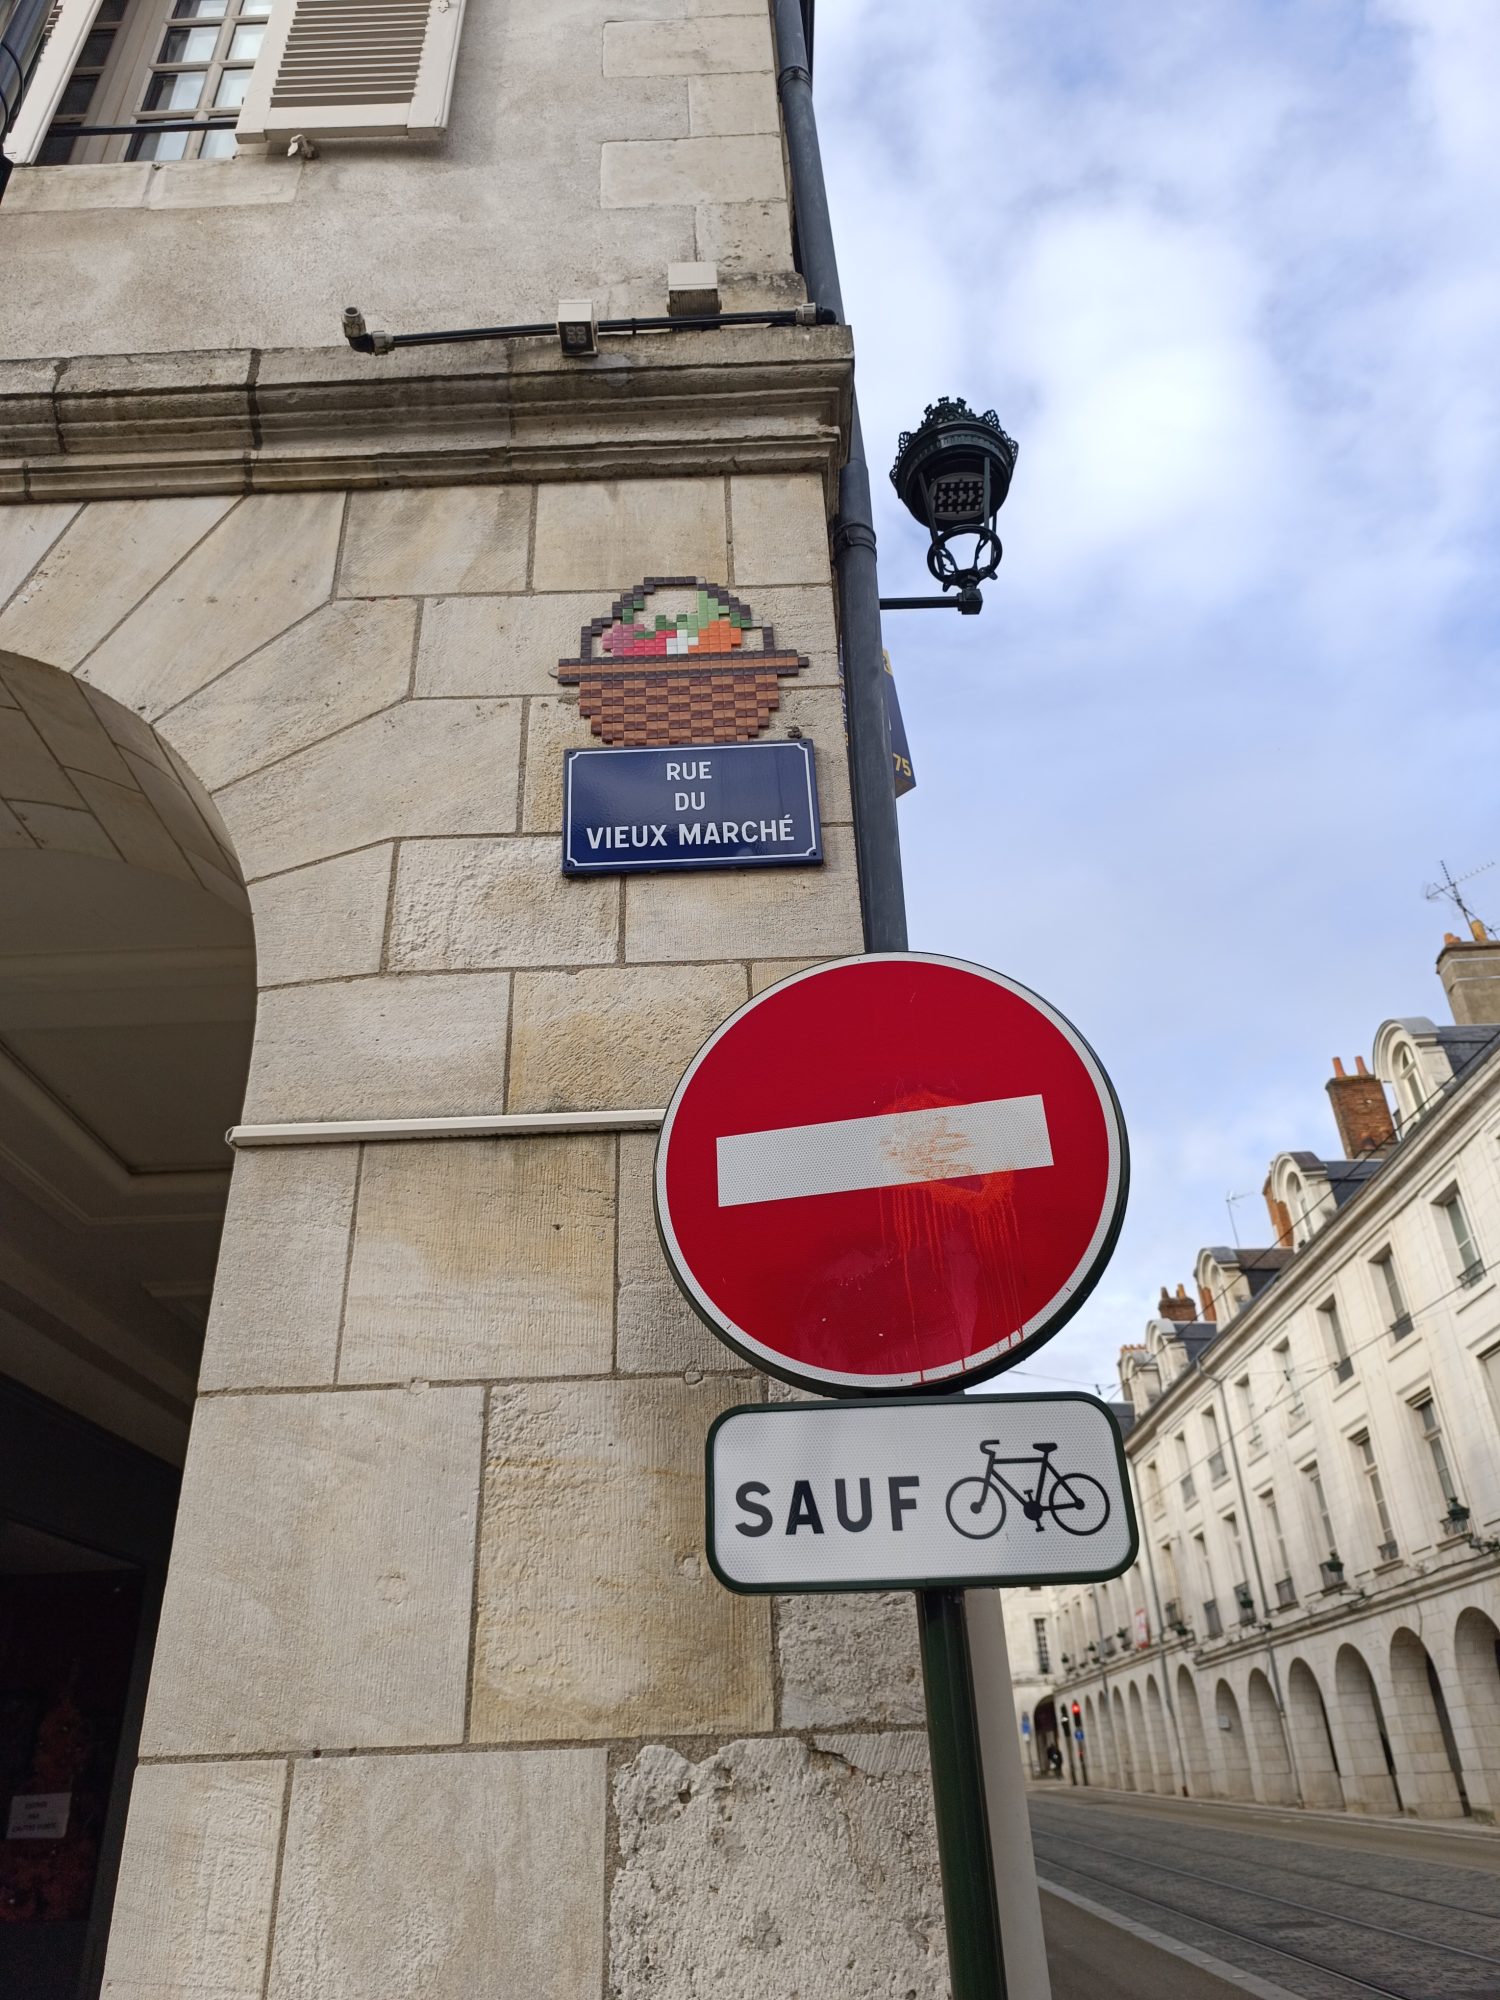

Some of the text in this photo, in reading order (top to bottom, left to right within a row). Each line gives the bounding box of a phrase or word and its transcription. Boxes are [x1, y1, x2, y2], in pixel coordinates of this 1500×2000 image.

[666, 761, 713, 781] RUE
[674, 791, 706, 812] DU
[586, 814, 795, 850] VIEUX MARCHÉ
[735, 1475, 920, 1538] SAUF
